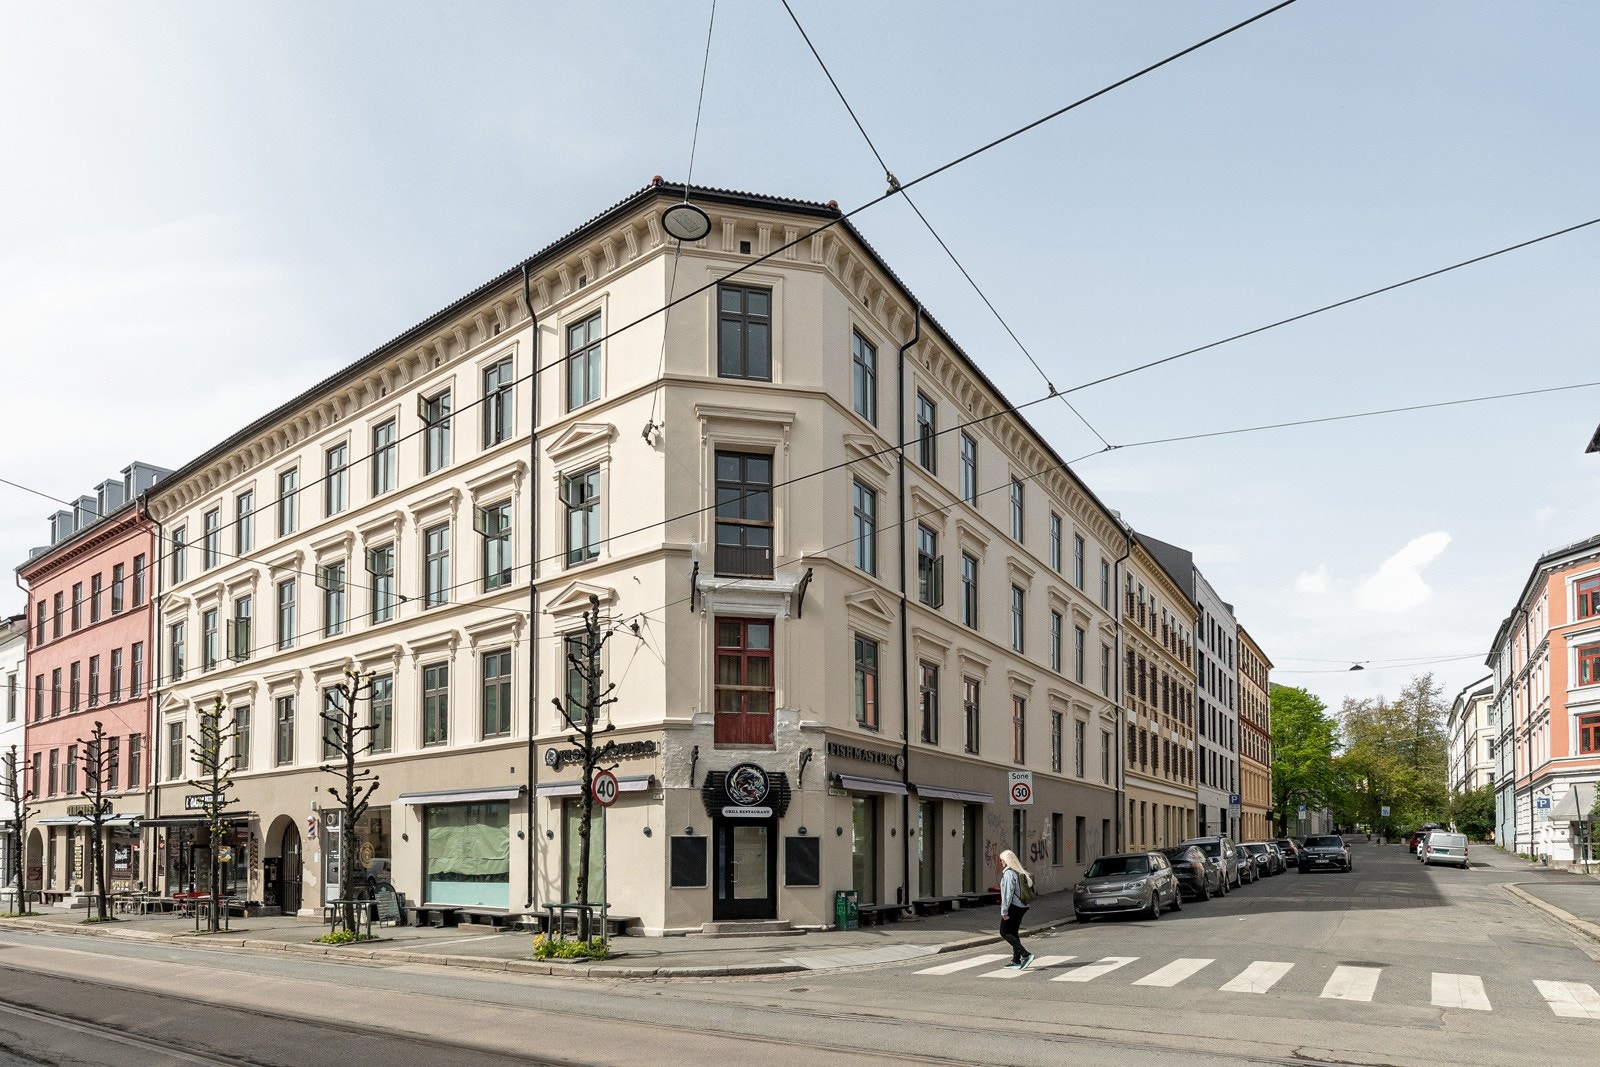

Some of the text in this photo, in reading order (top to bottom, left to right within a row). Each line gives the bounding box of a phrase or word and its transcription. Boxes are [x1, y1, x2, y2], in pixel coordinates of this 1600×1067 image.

[1012, 772, 1029, 780] Sone
[597, 780, 614, 798] 40
[1015, 787, 1028, 798] 30
[1231, 795, 1238, 804] P
[1540, 799, 1548, 808] P
